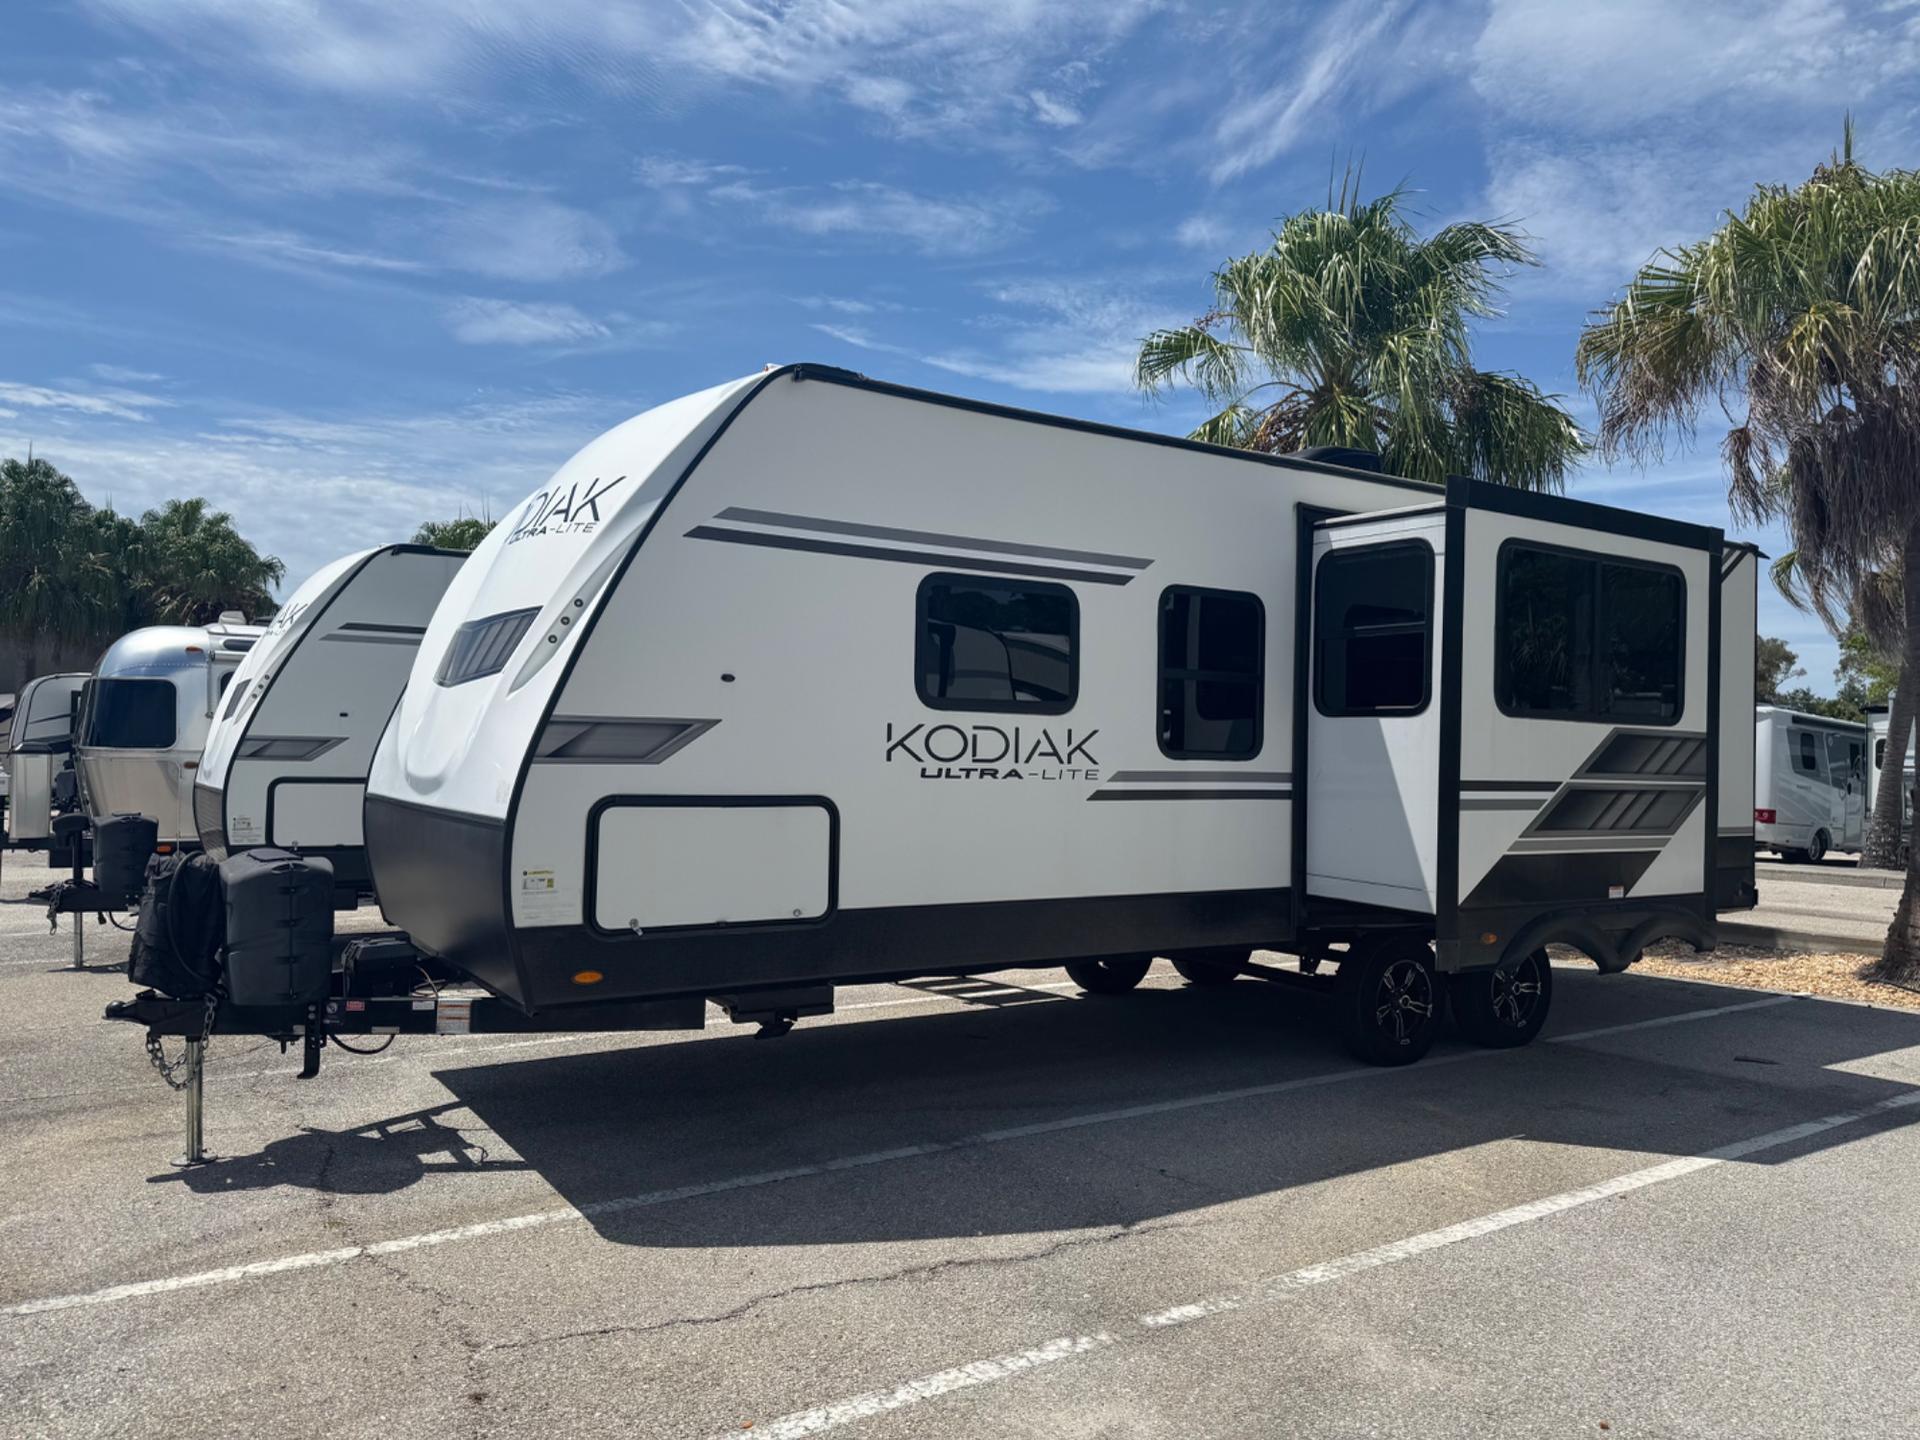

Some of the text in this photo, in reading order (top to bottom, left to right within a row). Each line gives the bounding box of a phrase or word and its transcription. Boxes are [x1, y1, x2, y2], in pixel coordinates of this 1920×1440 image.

[511, 475, 627, 534] DIAK
[886, 722, 1099, 765] KODIAK
[920, 767, 1099, 780] ULTRA-LITE
